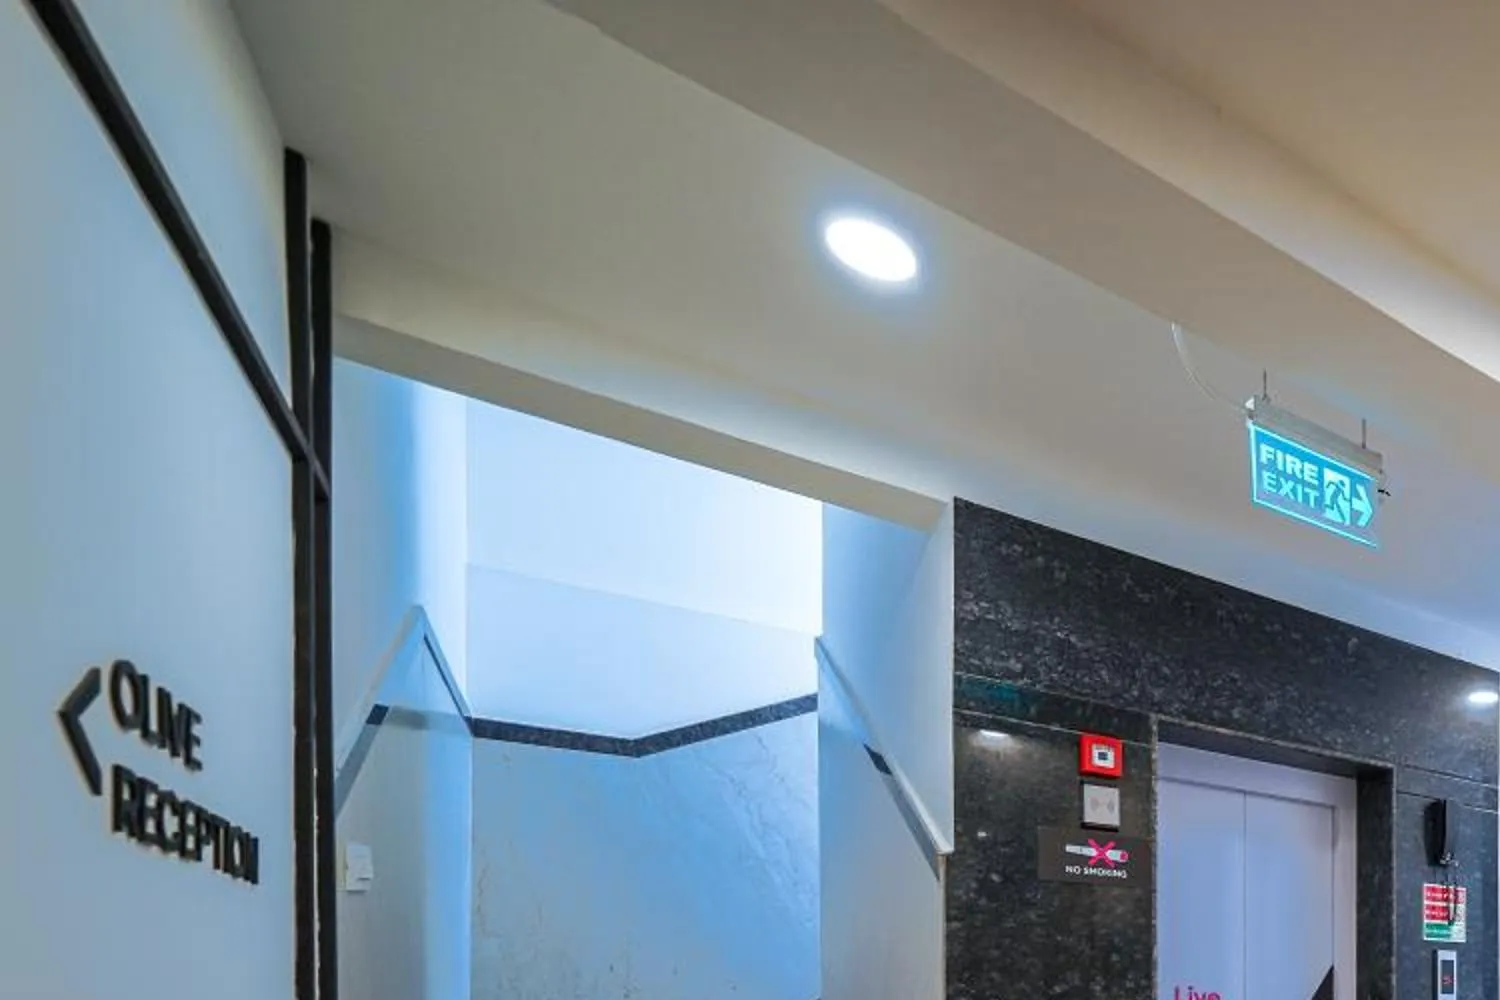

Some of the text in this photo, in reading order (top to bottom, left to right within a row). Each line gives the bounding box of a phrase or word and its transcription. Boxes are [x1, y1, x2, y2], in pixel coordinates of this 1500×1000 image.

[1260, 444, 1319, 486] FIRE
[1263, 471, 1319, 508] EXIT
[111, 763, 259, 885] RECEPTION
[1065, 865, 1127, 878] NO SMOKING
